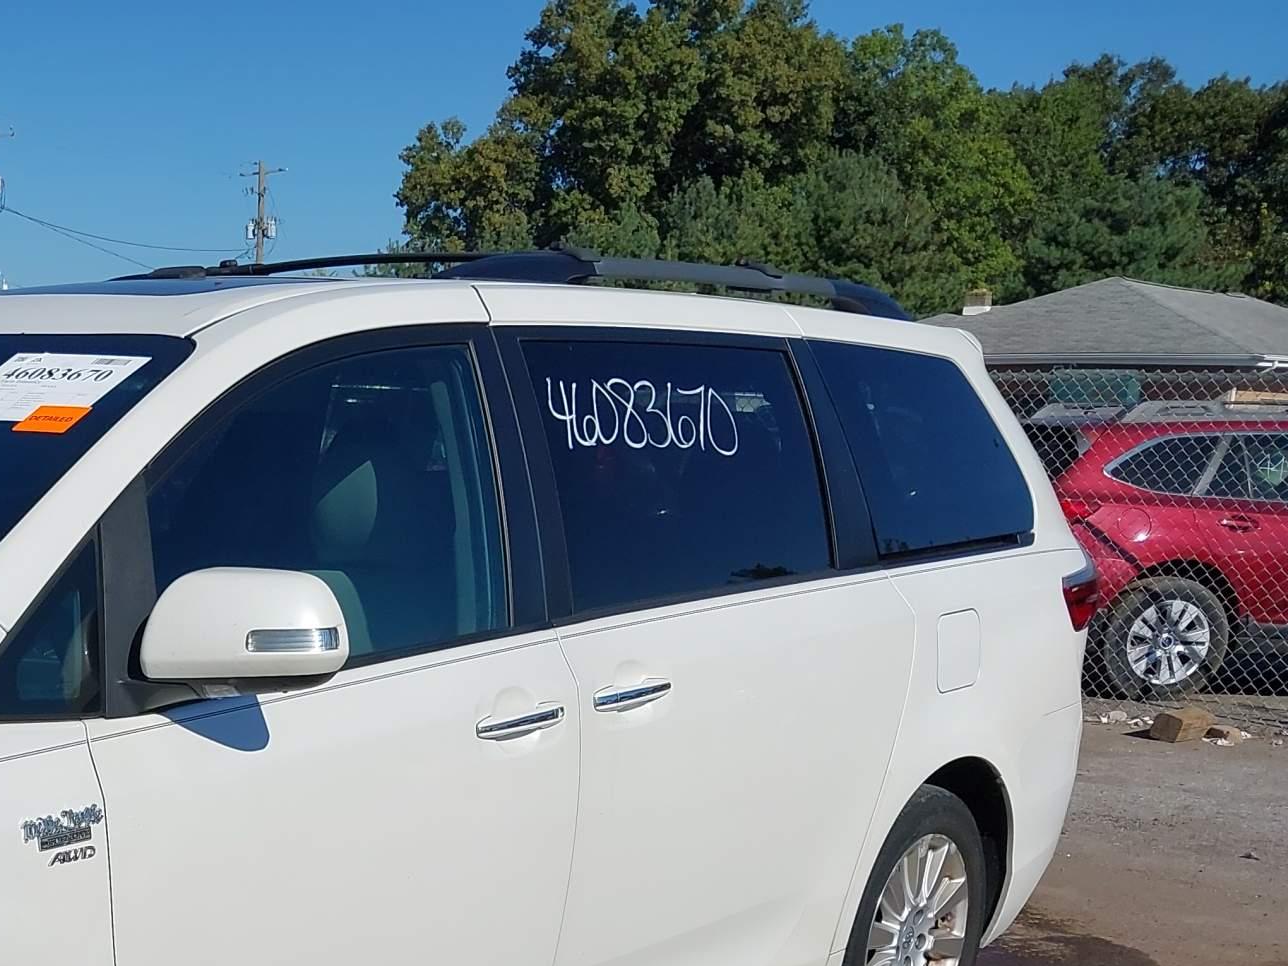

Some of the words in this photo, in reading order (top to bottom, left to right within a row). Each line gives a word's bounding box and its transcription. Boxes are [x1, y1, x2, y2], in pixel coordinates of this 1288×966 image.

[3, 366, 114, 382] 46083670
[28, 414, 74, 423] DETAILED
[545, 376, 739, 456] 46083670
[48, 845, 96, 867] AWD
